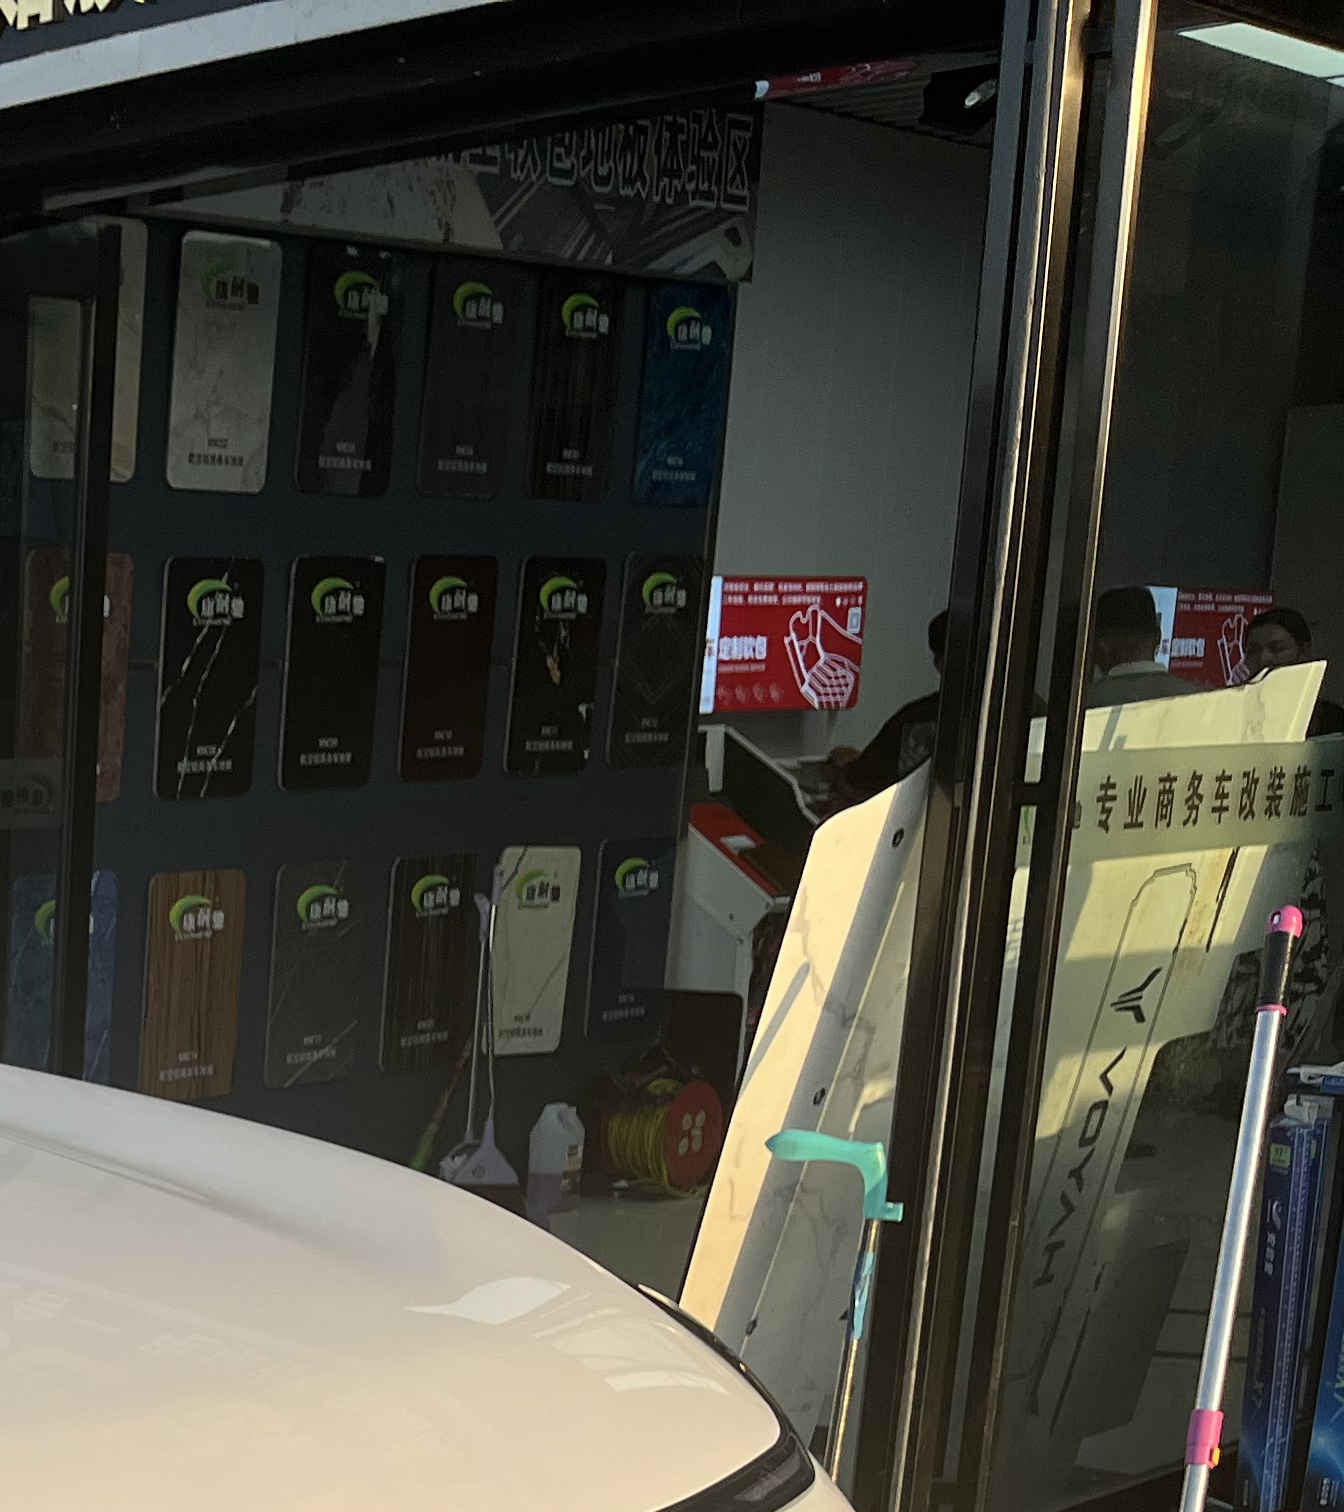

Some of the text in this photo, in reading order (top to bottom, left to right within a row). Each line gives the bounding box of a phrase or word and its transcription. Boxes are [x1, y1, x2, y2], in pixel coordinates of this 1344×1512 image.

[1096, 765, 1336, 834] 专业商务车改装施工
[1032, 1046, 1129, 1290] VOYAH
